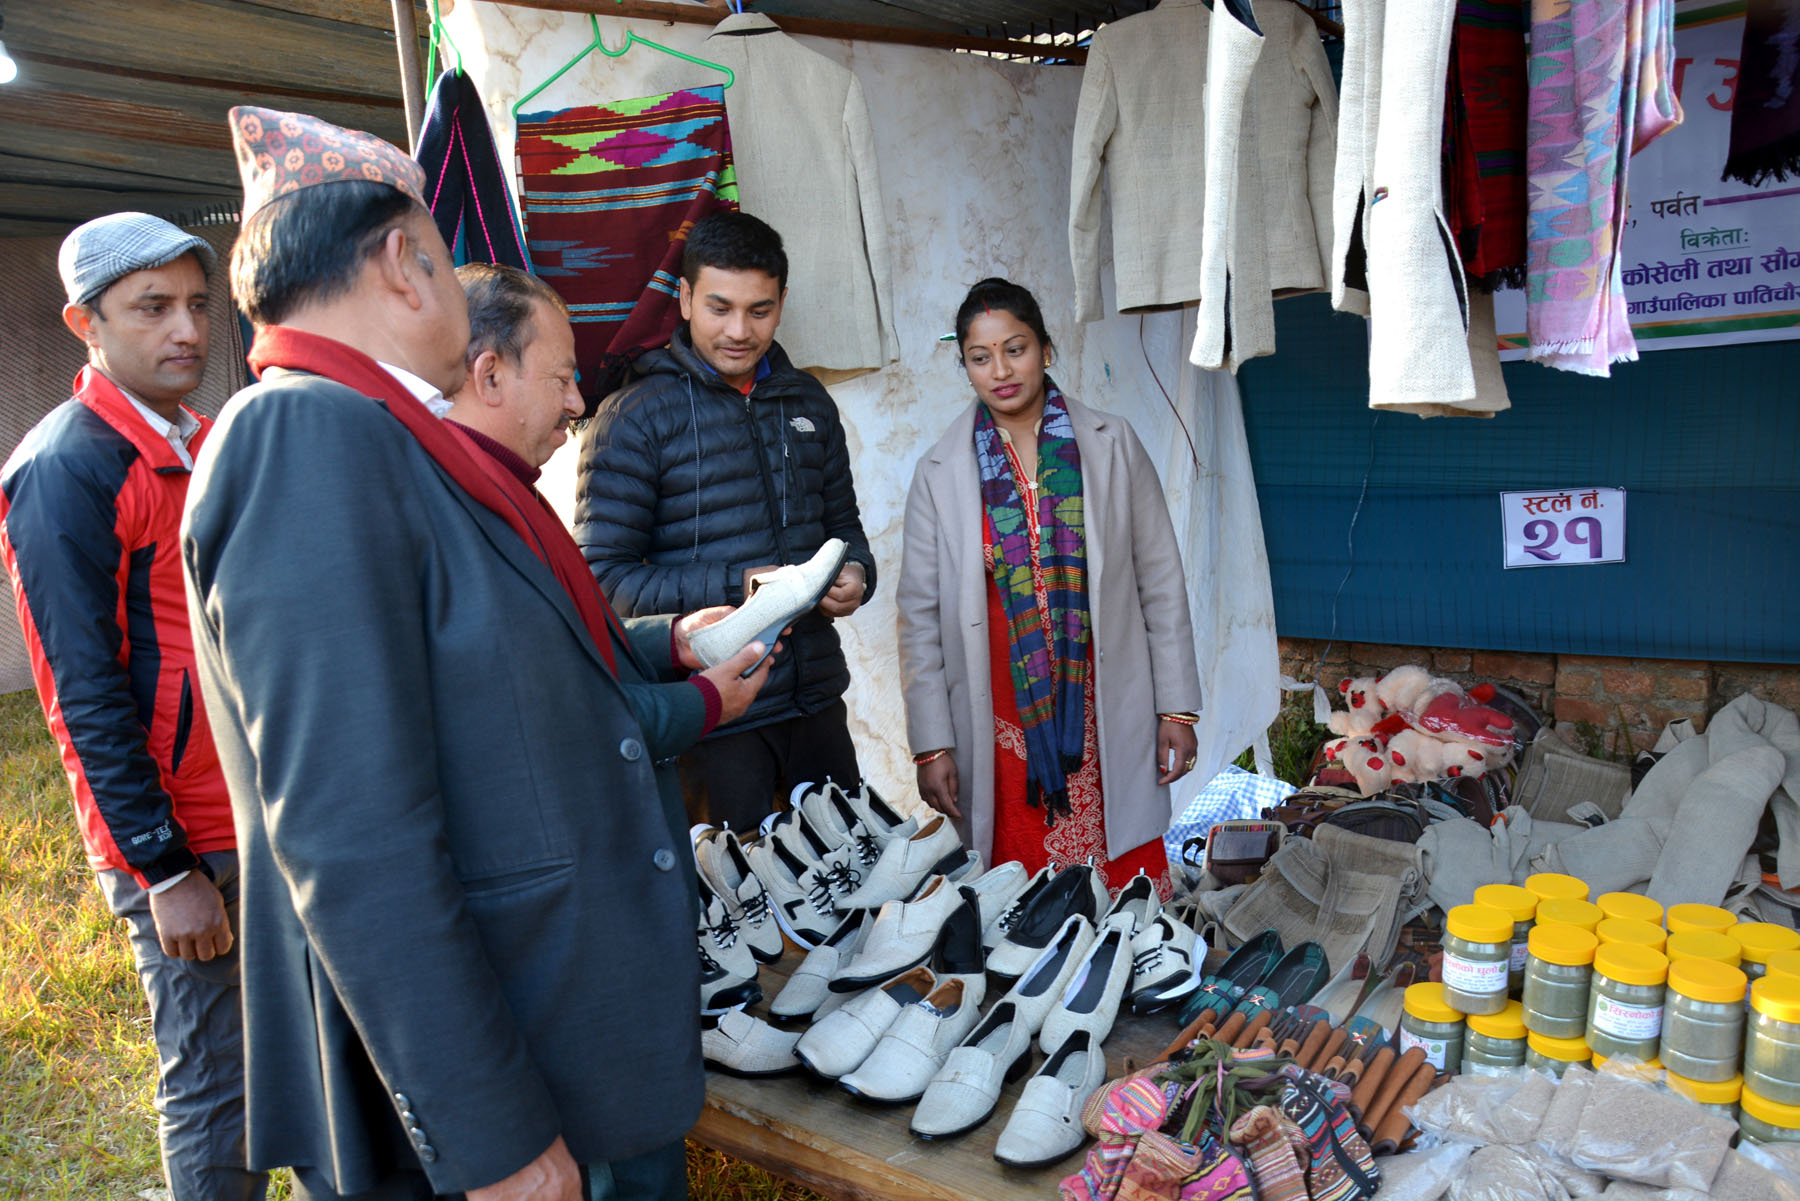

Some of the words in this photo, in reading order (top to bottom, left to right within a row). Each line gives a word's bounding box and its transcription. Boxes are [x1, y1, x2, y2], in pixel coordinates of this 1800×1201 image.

[1651, 190, 1701, 219] पर्वत
[1622, 258, 1700, 286] कोसेली
[1707, 257, 1753, 279] तथा
[1627, 291, 1727, 315] गाउँपालिका
[1523, 516, 1603, 561] २१
